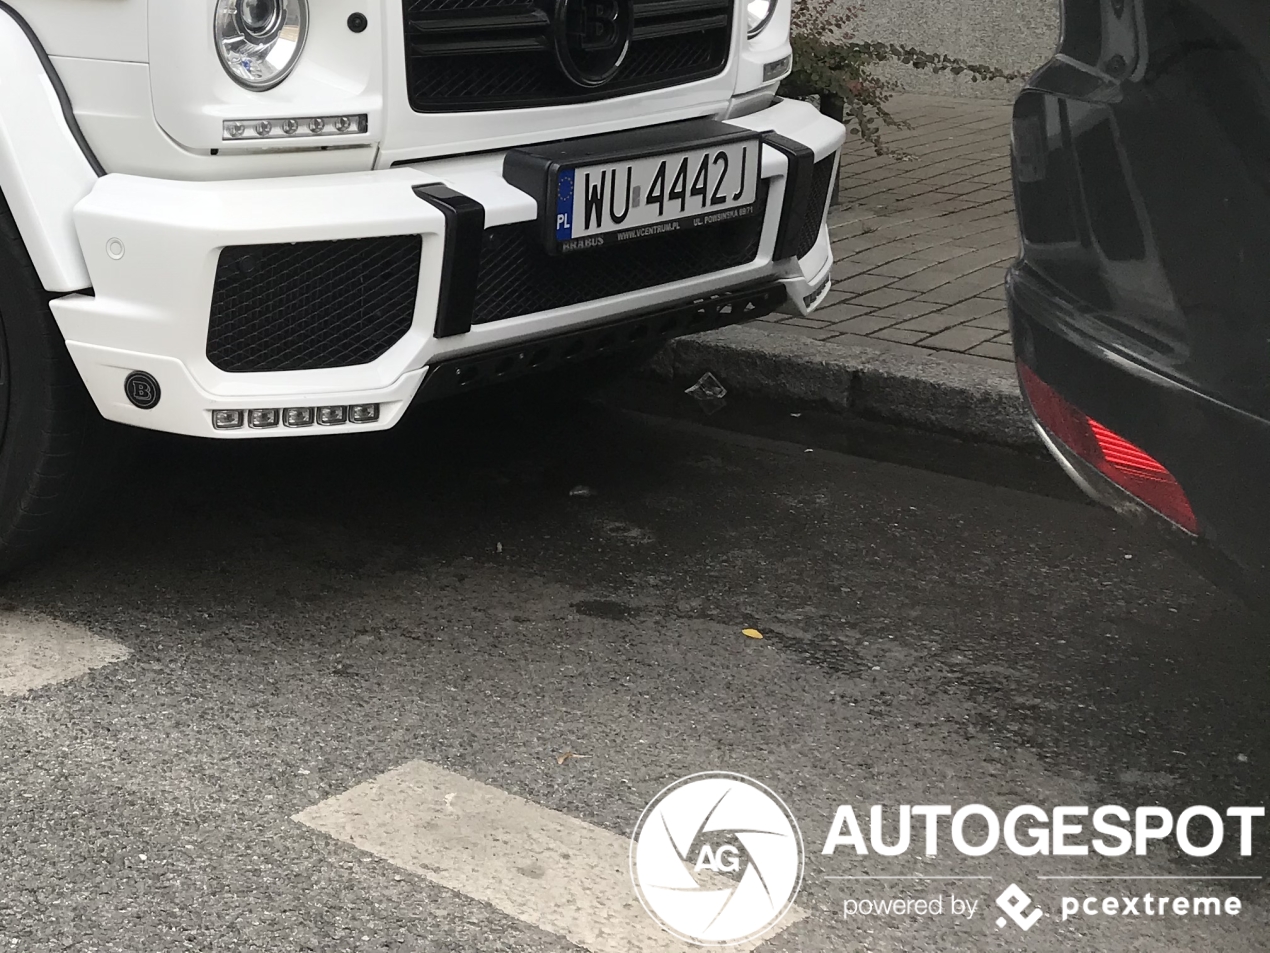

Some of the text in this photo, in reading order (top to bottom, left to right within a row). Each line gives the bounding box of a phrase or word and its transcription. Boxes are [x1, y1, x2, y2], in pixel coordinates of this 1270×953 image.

[584, 146, 747, 230] WU 4442J
[556, 213, 570, 230] PL
[132, 380, 152, 401] B
